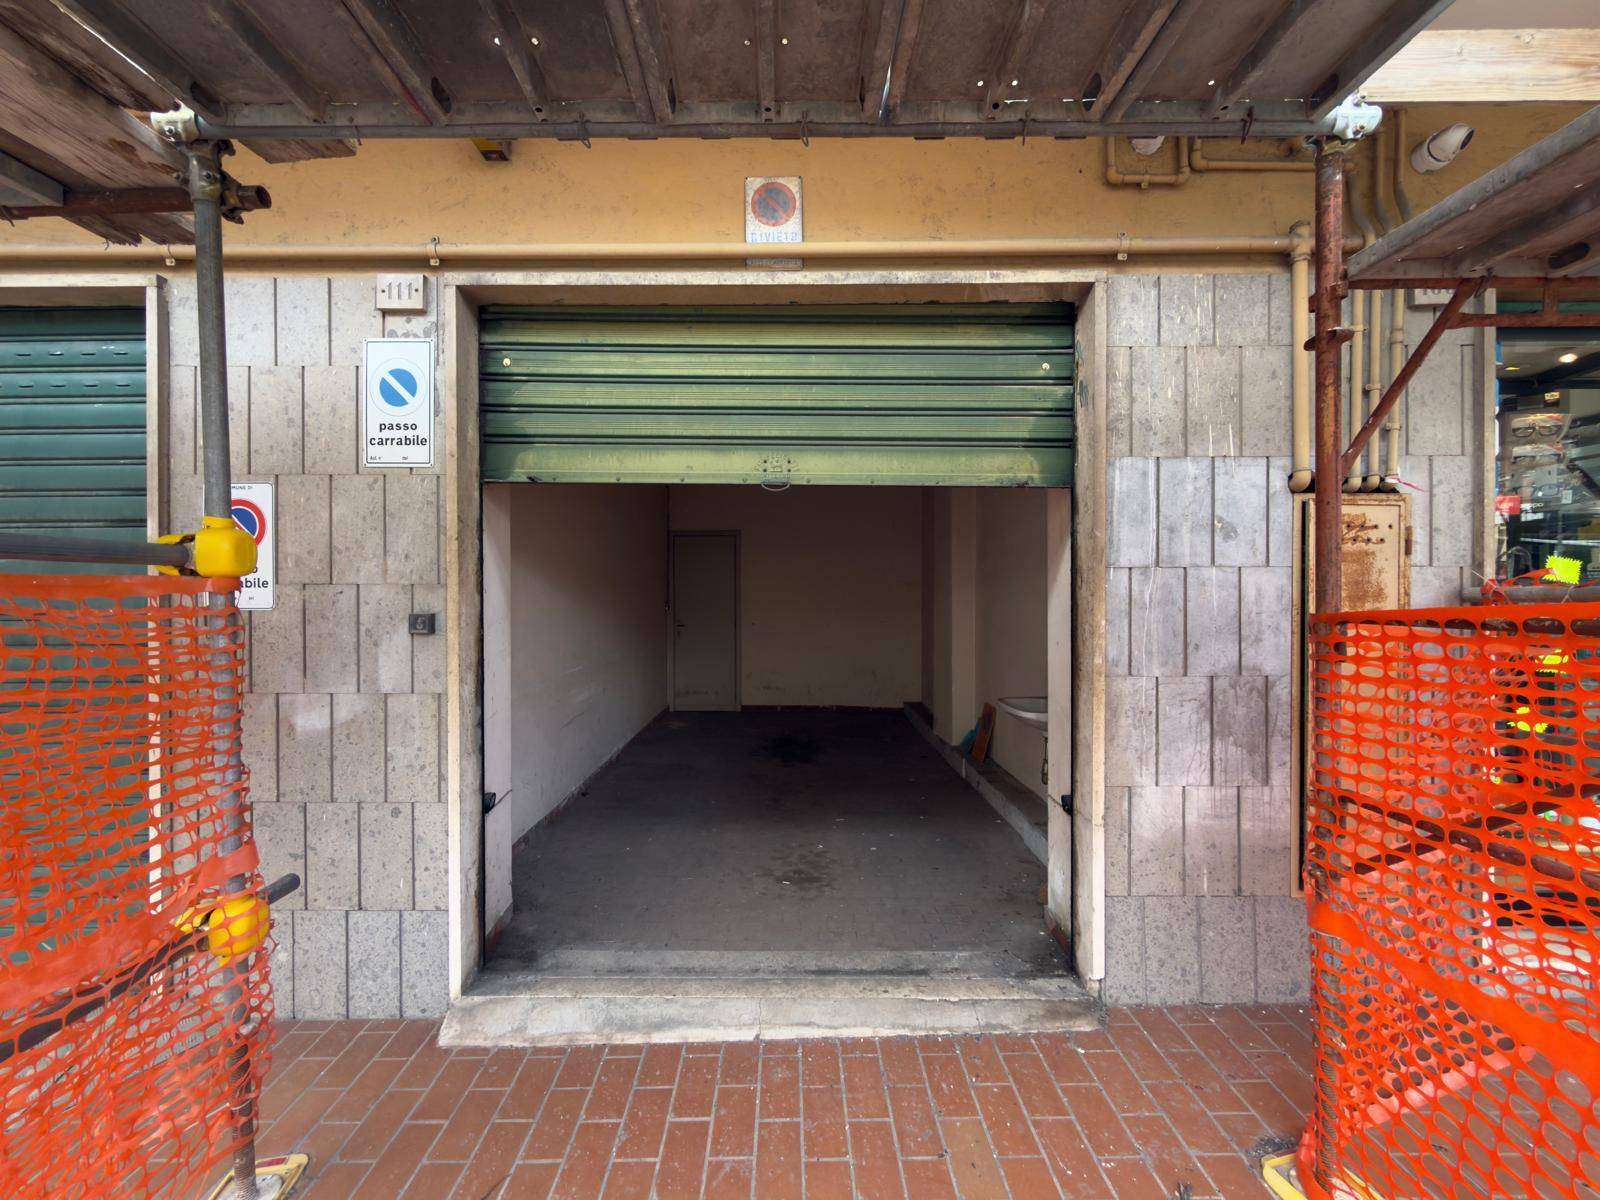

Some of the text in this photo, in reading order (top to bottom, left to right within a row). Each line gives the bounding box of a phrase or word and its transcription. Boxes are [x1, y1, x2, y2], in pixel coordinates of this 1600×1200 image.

[386, 281, 413, 300] 111
[379, 423, 418, 433] passo
[369, 434, 428, 446] carrabile
